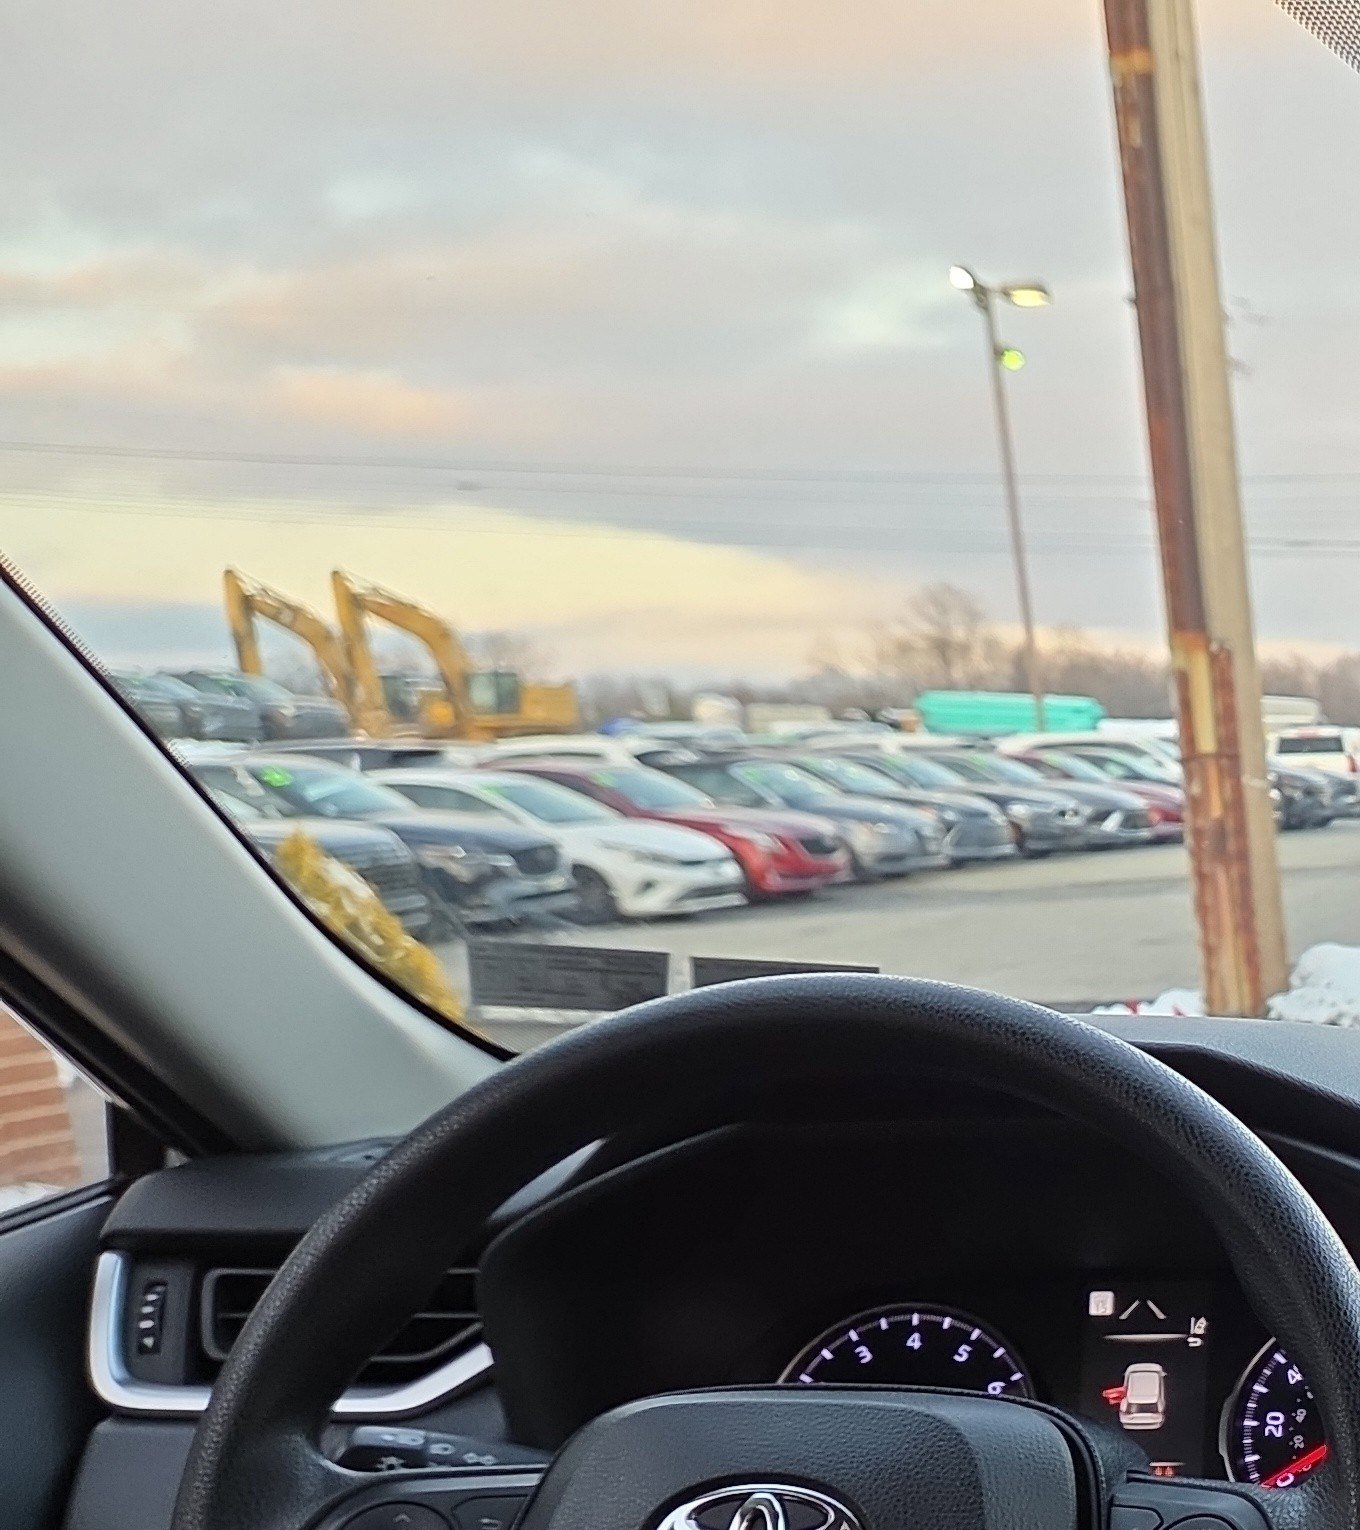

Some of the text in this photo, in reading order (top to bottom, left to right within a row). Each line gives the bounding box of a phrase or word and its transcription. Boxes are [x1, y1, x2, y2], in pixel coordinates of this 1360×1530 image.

[906, 1332, 922, 1350] 4
[855, 1345, 873, 1363] 3
[953, 1344, 973, 1362] 5
[987, 1381, 1006, 1395] 6
[1265, 1411, 1285, 1437] 20
